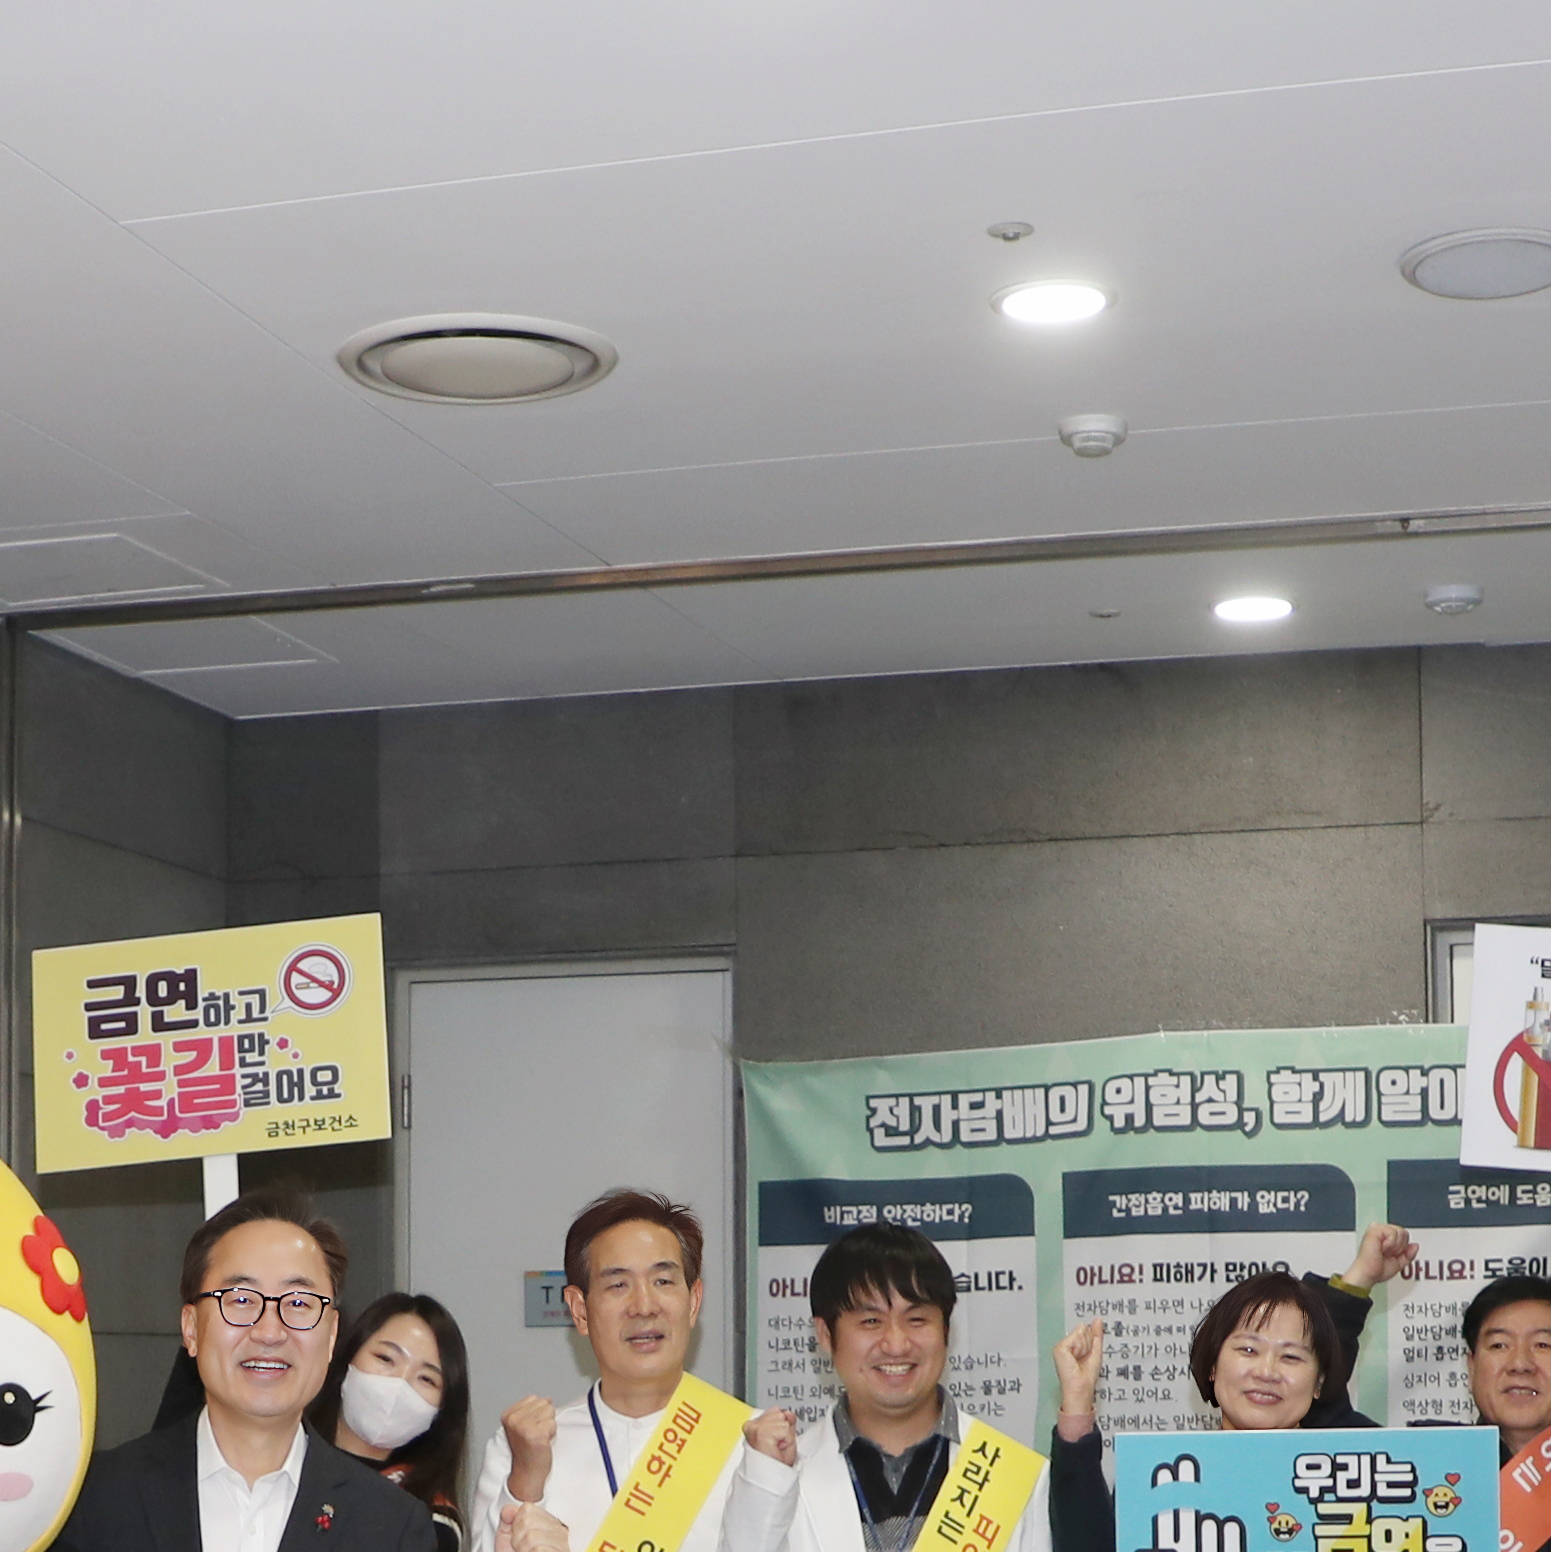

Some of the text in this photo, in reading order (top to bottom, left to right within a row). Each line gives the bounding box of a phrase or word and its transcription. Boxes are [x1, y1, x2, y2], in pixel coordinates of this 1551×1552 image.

[84, 967, 271, 1040] 금연하고
[98, 1032, 270, 1123] 꽃길만
[241, 1064, 342, 1108] 걸어요
[866, 1080, 1093, 1150] 전자담배의
[1103, 1069, 1261, 1136] 위험성,
[1268, 1068, 1370, 1126] 함께
[265, 1115, 359, 1138] 금천구보건소
[1109, 1190, 1309, 1217] 간접흡연 피해가 없다?
[1448, 1183, 1509, 1209] 금연에
[824, 1203, 973, 1226] 비교적 안전하다?
[1076, 1261, 1217, 1286] 아니요! 피해가
[1400, 1258, 1475, 1281] 아니요!
[1483, 1256, 1548, 1279] 도움이
[1074, 1297, 1185, 1317] 전자담배를 피우면
[1402, 1323, 1462, 1341] 일반담배
[768, 1337, 819, 1352] 니코틴을
[1103, 1342, 1159, 1359] 수증기가
[1403, 1345, 1428, 1362] 멀티
[768, 1358, 806, 1374] 그래서
[949, 1352, 1007, 1371] 있습니다.
[1116, 1364, 1144, 1381] 폐를
[768, 1384, 804, 1401] 니코틴
[949, 1381, 976, 1397] 있는
[980, 1377, 1023, 1396] 물질과
[1403, 1371, 1441, 1389] 심지어
[1132, 1386, 1178, 1403] 있어요.
[960, 1401, 1005, 1417] 으키는
[1402, 1398, 1443, 1415] 액상형
[1293, 1452, 1416, 1501] 우리는
[937, 1440, 1001, 1545] 사라지는
